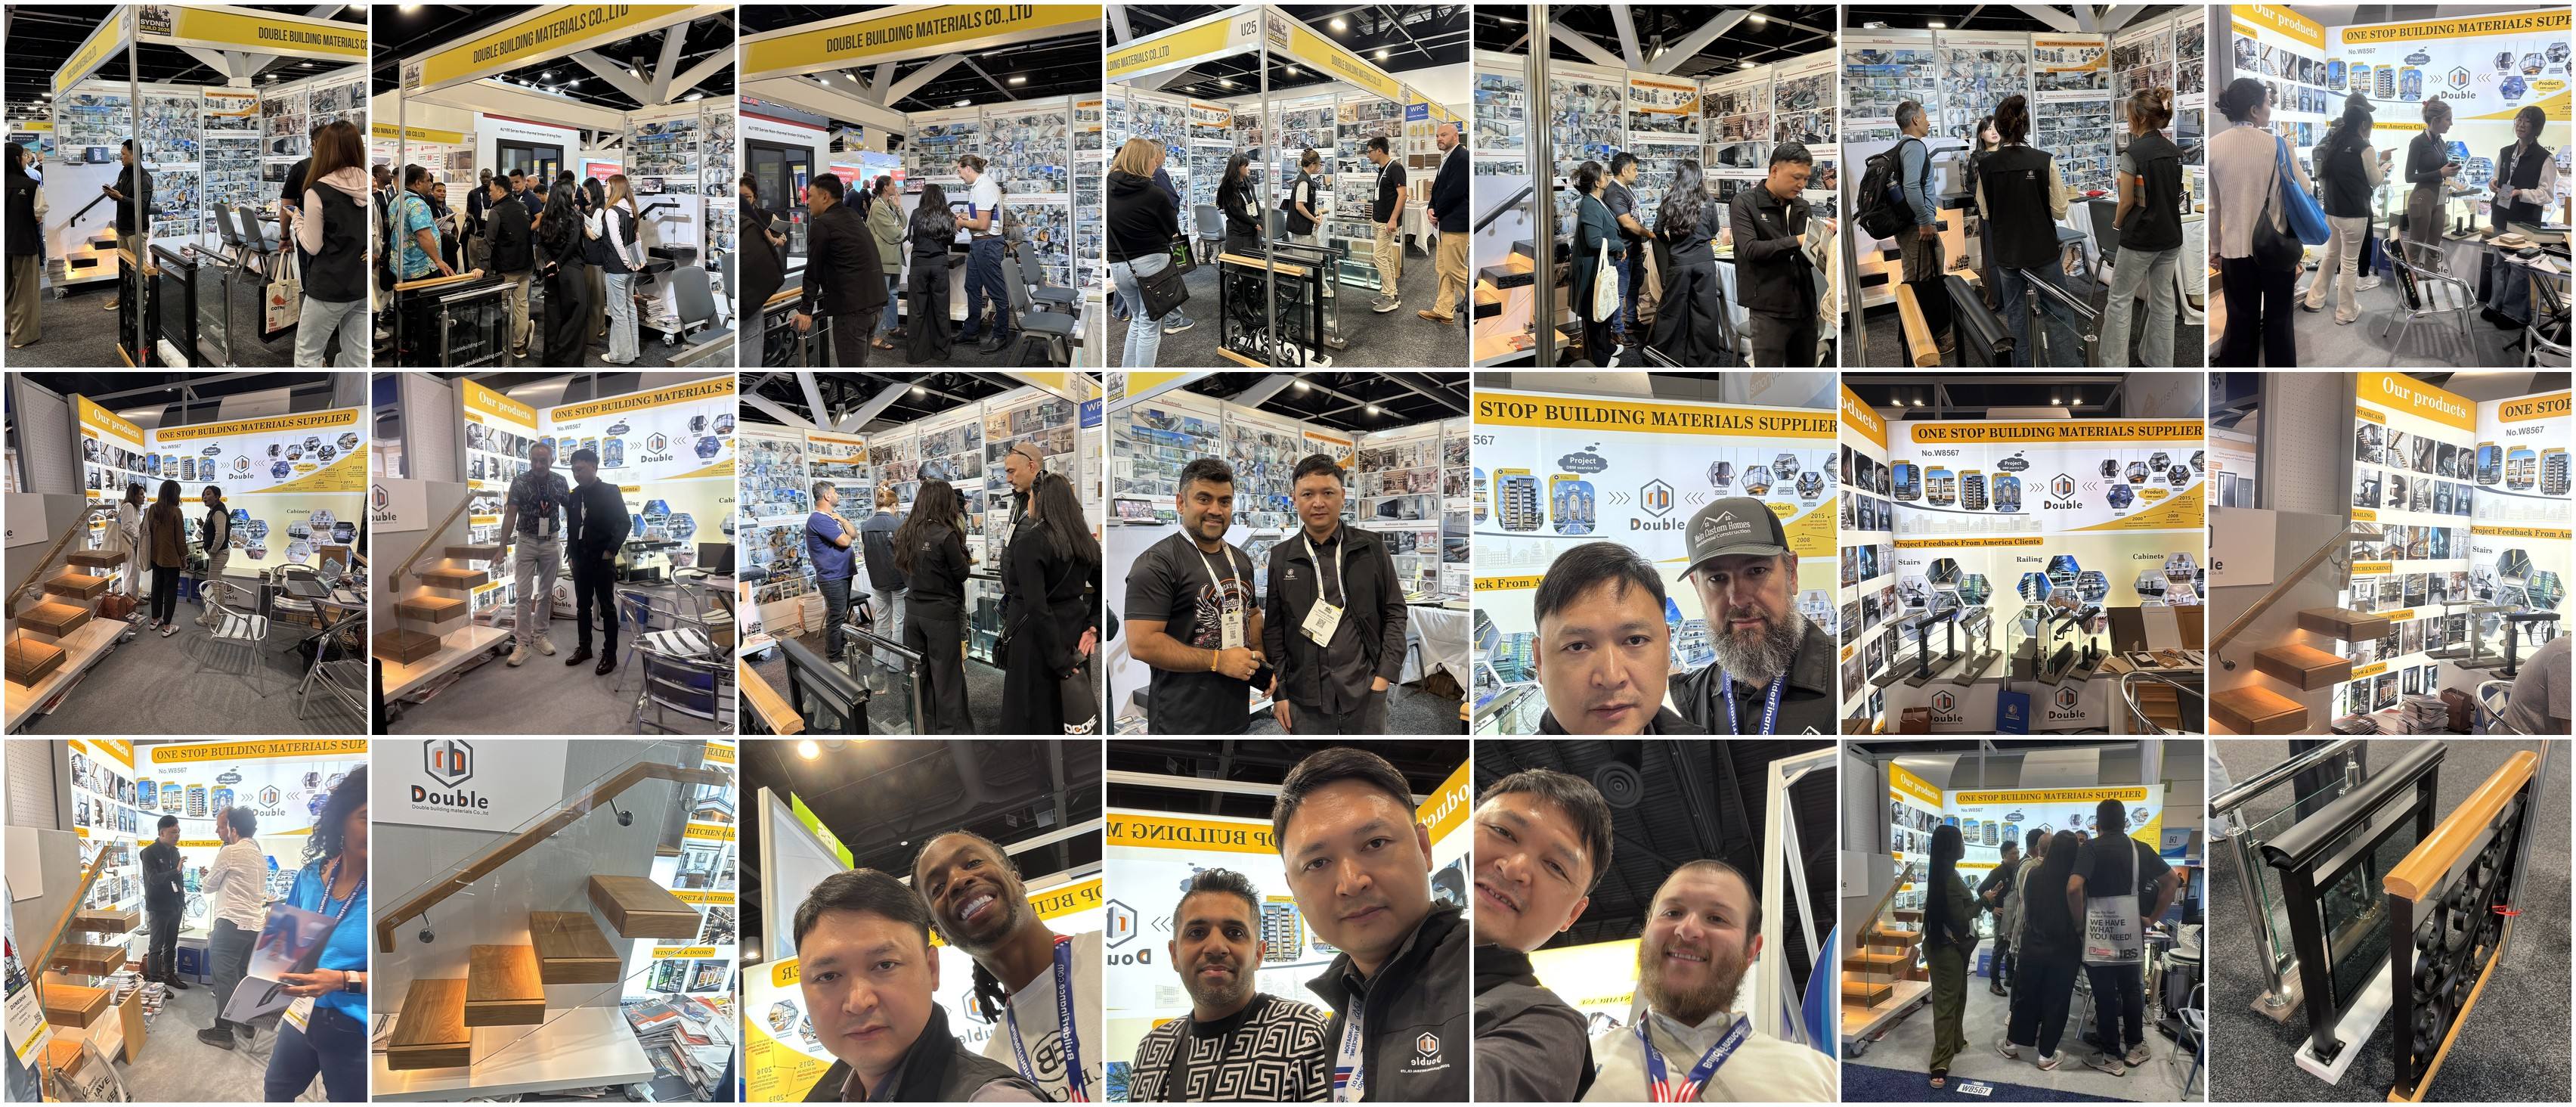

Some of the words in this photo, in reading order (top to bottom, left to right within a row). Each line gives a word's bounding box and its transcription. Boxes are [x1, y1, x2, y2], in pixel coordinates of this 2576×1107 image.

[140, 19, 170, 28] SYDNEY
[1241, 20, 1257, 36] U25
[2252, 5, 2274, 20] Our
[2278, 11, 2318, 40] products
[2347, 30, 2367, 41] ONE
[2370, 29, 2396, 39] STOP
[2400, 25, 2455, 37] BUILDING
[2458, 18, 2533, 35] MATERIALS
[259, 26, 288, 41] DOUBLE
[289, 30, 321, 45] BUILDING
[323, 34, 360, 49] MATERIALS
[473, 44, 498, 64] DOUBLE
[500, 34, 534, 54] BUILDING
[535, 13, 586, 44] MATERIALS
[827, 33, 862, 53] DOUBLE
[865, 24, 913, 46] BUILDING
[916, 11, 982, 38] MATERIALS
[1268, 29, 1287, 41] SYDNEY
[1121, 53, 1149, 67] MATERIALS
[1149, 45, 1169, 60] CO.,LTD
[2441, 90, 2476, 100] Double
[556, 411, 571, 420] ONE
[574, 406, 599, 417] STOP
[601, 397, 651, 414] BUILDING
[654, 384, 723, 406] MATERIALS
[2382, 377, 2410, 400] Our
[2413, 390, 2466, 418] products
[478, 391, 497, 408] Our
[498, 398, 531, 421] products
[2505, 403, 2533, 417] ONE
[1480, 401, 1538, 419] STOP
[1545, 405, 1646, 426] BUILDING
[1651, 411, 1754, 430] MATERIALS
[2357, 408, 2384, 421] STAIRCASE
[93, 408, 110, 425] Our
[111, 416, 140, 439] products
[159, 429, 175, 439] ONE
[177, 428, 197, 438] STOP
[198, 424, 239, 436] BUILDING
[240, 419, 294, 433] MATERIALS
[297, 412, 351, 426] SUPPLIER
[1918, 429, 1946, 439] ONE
[1951, 428, 1986, 439] STOP
[1989, 427, 2055, 438] BUILDING
[2059, 426, 2135, 437] MATERIALS
[2138, 424, 2203, 436] SUPPLIER
[2506, 426, 2544, 436] No.W8567
[1474, 435, 1495, 445] 567
[641, 453, 673, 463] Double
[1565, 456, 1593, 465] Project
[2044, 501, 2083, 510] Double
[1630, 517, 1686, 531] Double
[1704, 526, 1723, 538] Custom
[1726, 521, 1751, 532] Homes
[1716, 528, 1751, 540] Construction
[2471, 527, 2496, 535] Project
[2497, 527, 2533, 536] Feedback
[2535, 529, 2554, 538] From
[1894, 540, 1921, 548] Project
[2472, 545, 2493, 554] Stairs
[2048, 710, 2085, 719] Double
[157, 750, 178, 759] ONE
[181, 748, 208, 758] STOP
[211, 745, 265, 757] BUILDING
[268, 740, 337, 755] MATERIALS
[1900, 774, 1914, 788] Our
[1915, 783, 1938, 801] products
[410, 784, 489, 809] Double
[1959, 794, 1975, 802] ONE
[1978, 793, 1999, 802] STOP
[2001, 792, 2041, 801] BUILDING
[2043, 791, 2093, 800] MATERIALS
[2095, 790, 2141, 799] SUPPLIER
[687, 827, 722, 837] KITCHEN
[2109, 932, 2132, 941] NEED!
[2119, 948, 2138, 959] IBS
[1961, 1085, 1989, 1094] W8567
